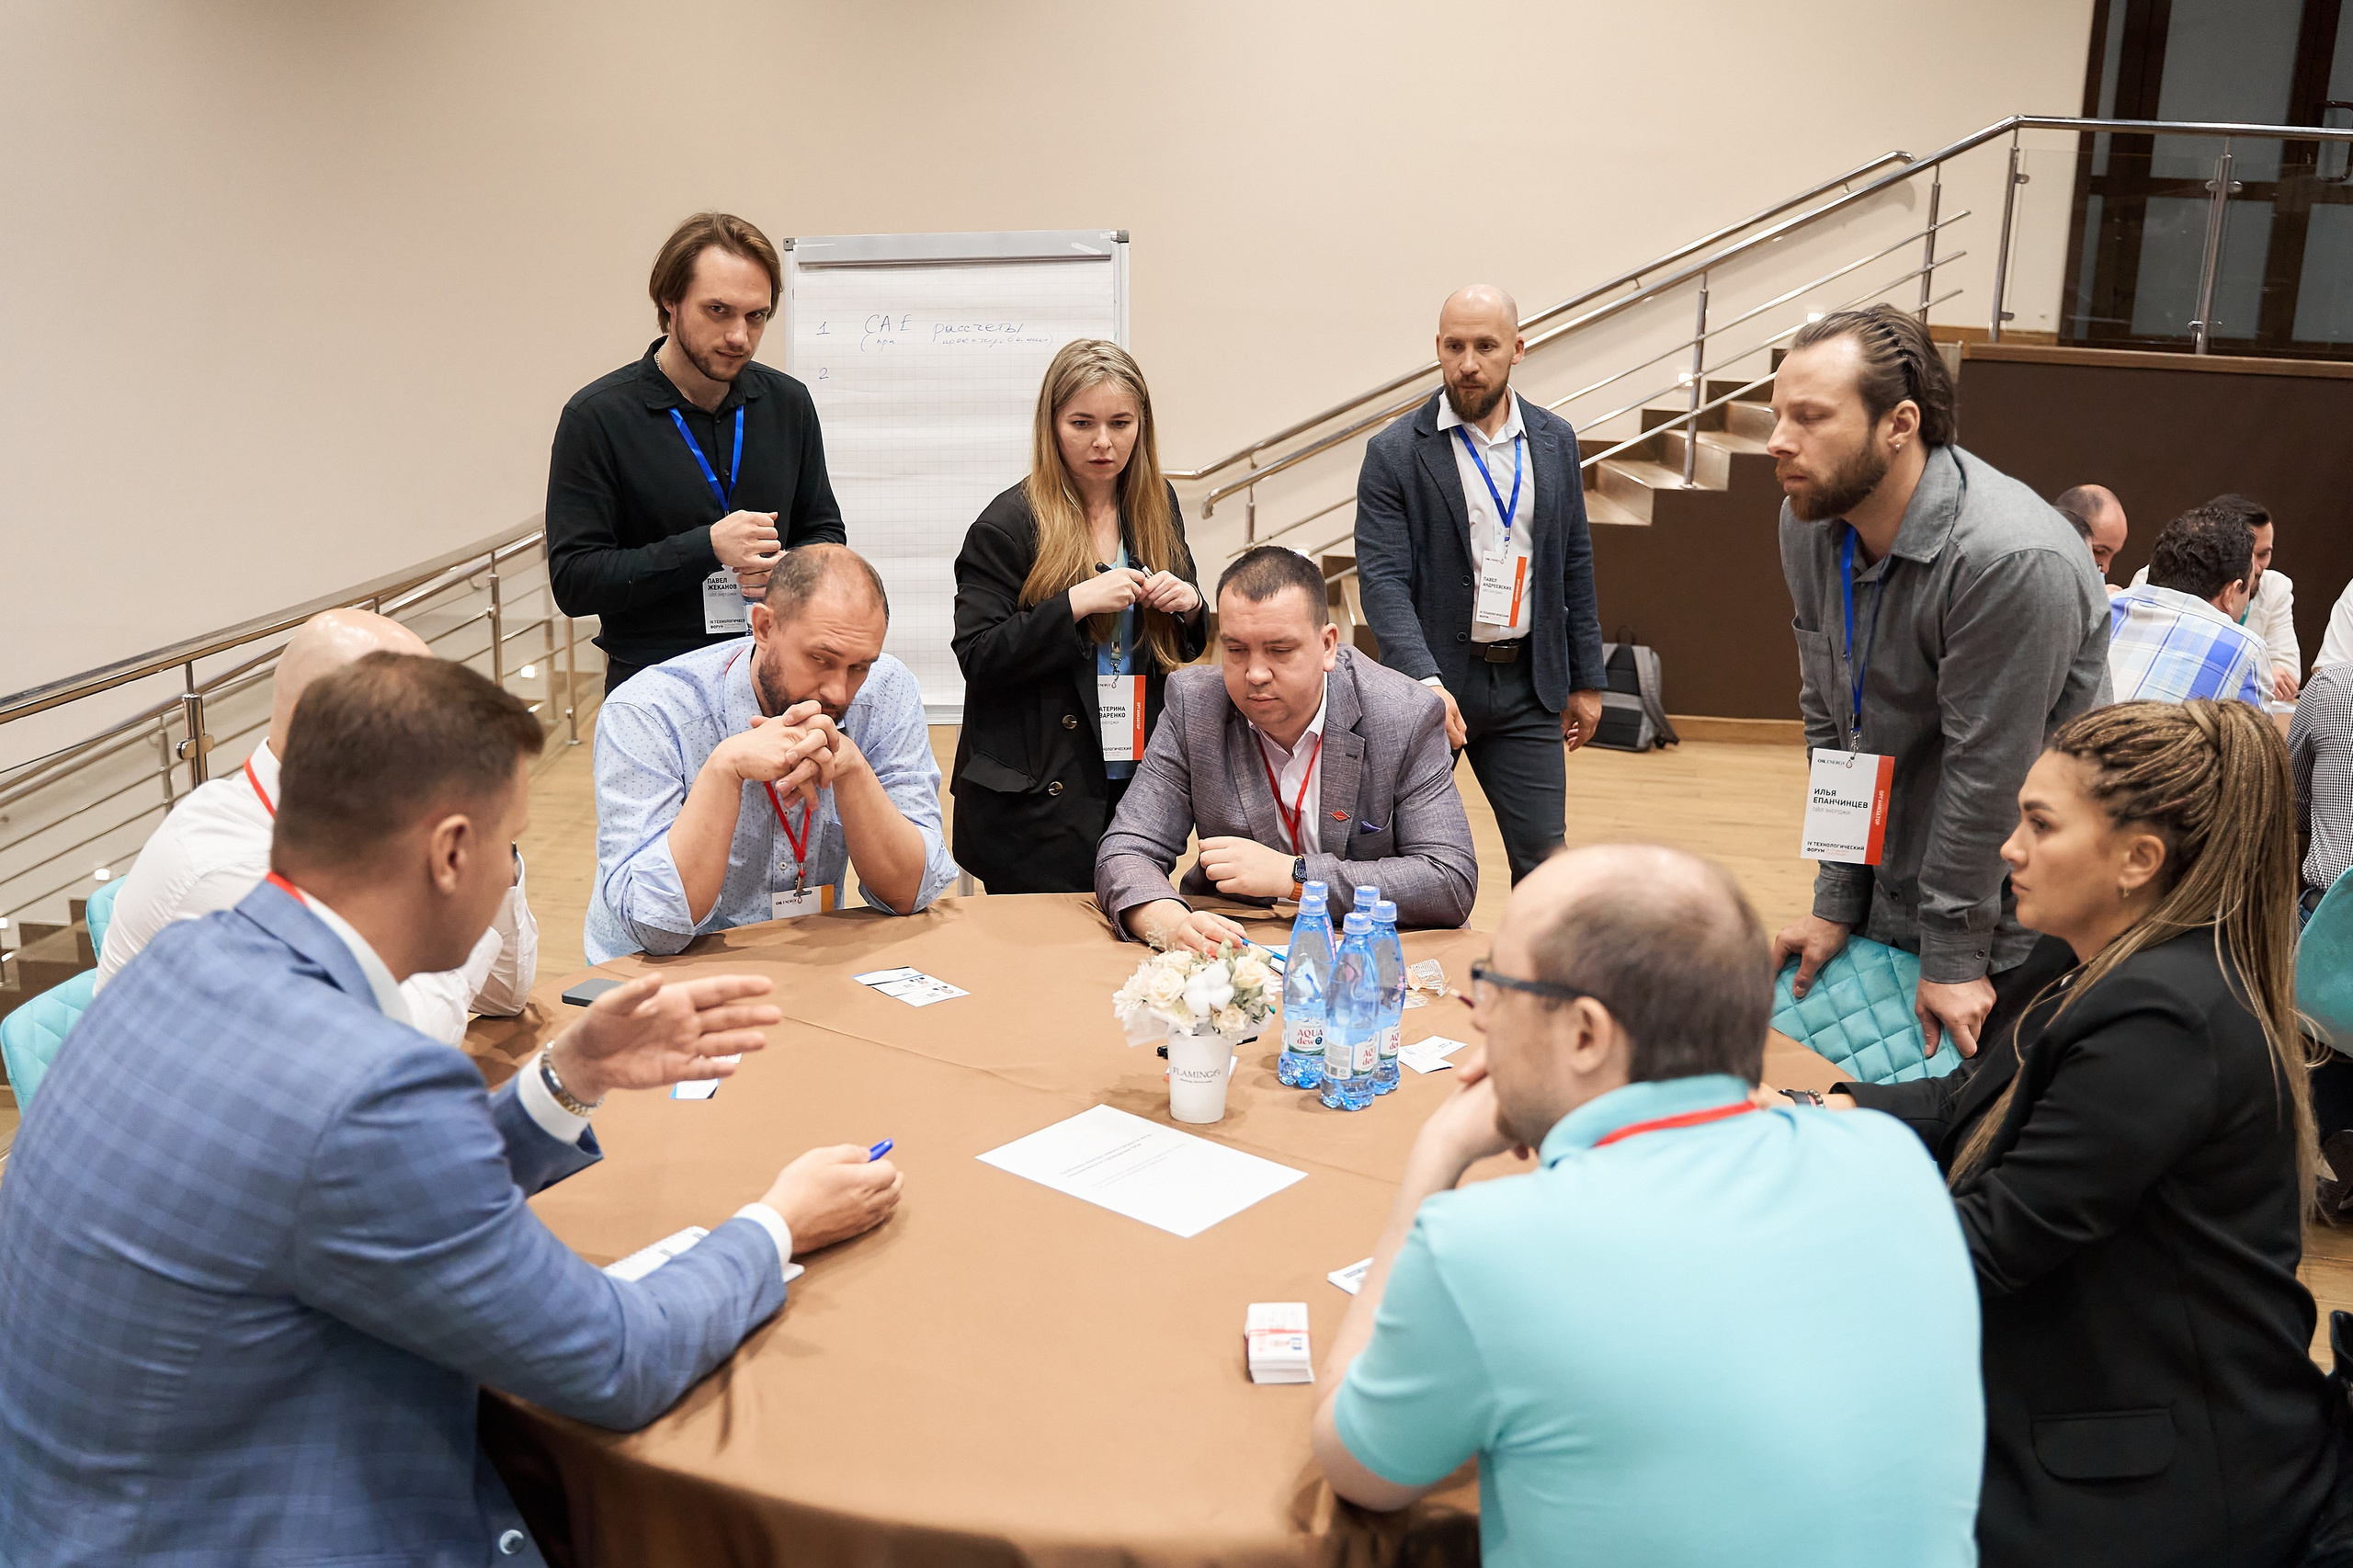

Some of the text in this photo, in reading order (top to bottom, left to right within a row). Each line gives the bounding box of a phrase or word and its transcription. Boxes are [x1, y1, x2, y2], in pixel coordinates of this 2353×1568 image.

[816, 321, 830, 335] 1
[818, 368, 829, 380] 2
[1813, 788, 1836, 797] ИЛЬЯ
[1813, 796, 1869, 809] ЕПАНЧИНЦЕВ
[1813, 841, 1865, 851] ТЕХНОЛОГИЧЕСКИЙ
[1297, 1028, 1324, 1039] AQUA
[1390, 1032, 1399, 1042] AQ
[1296, 1037, 1314, 1045] dew
[1363, 1048, 1374, 1058] AQ
